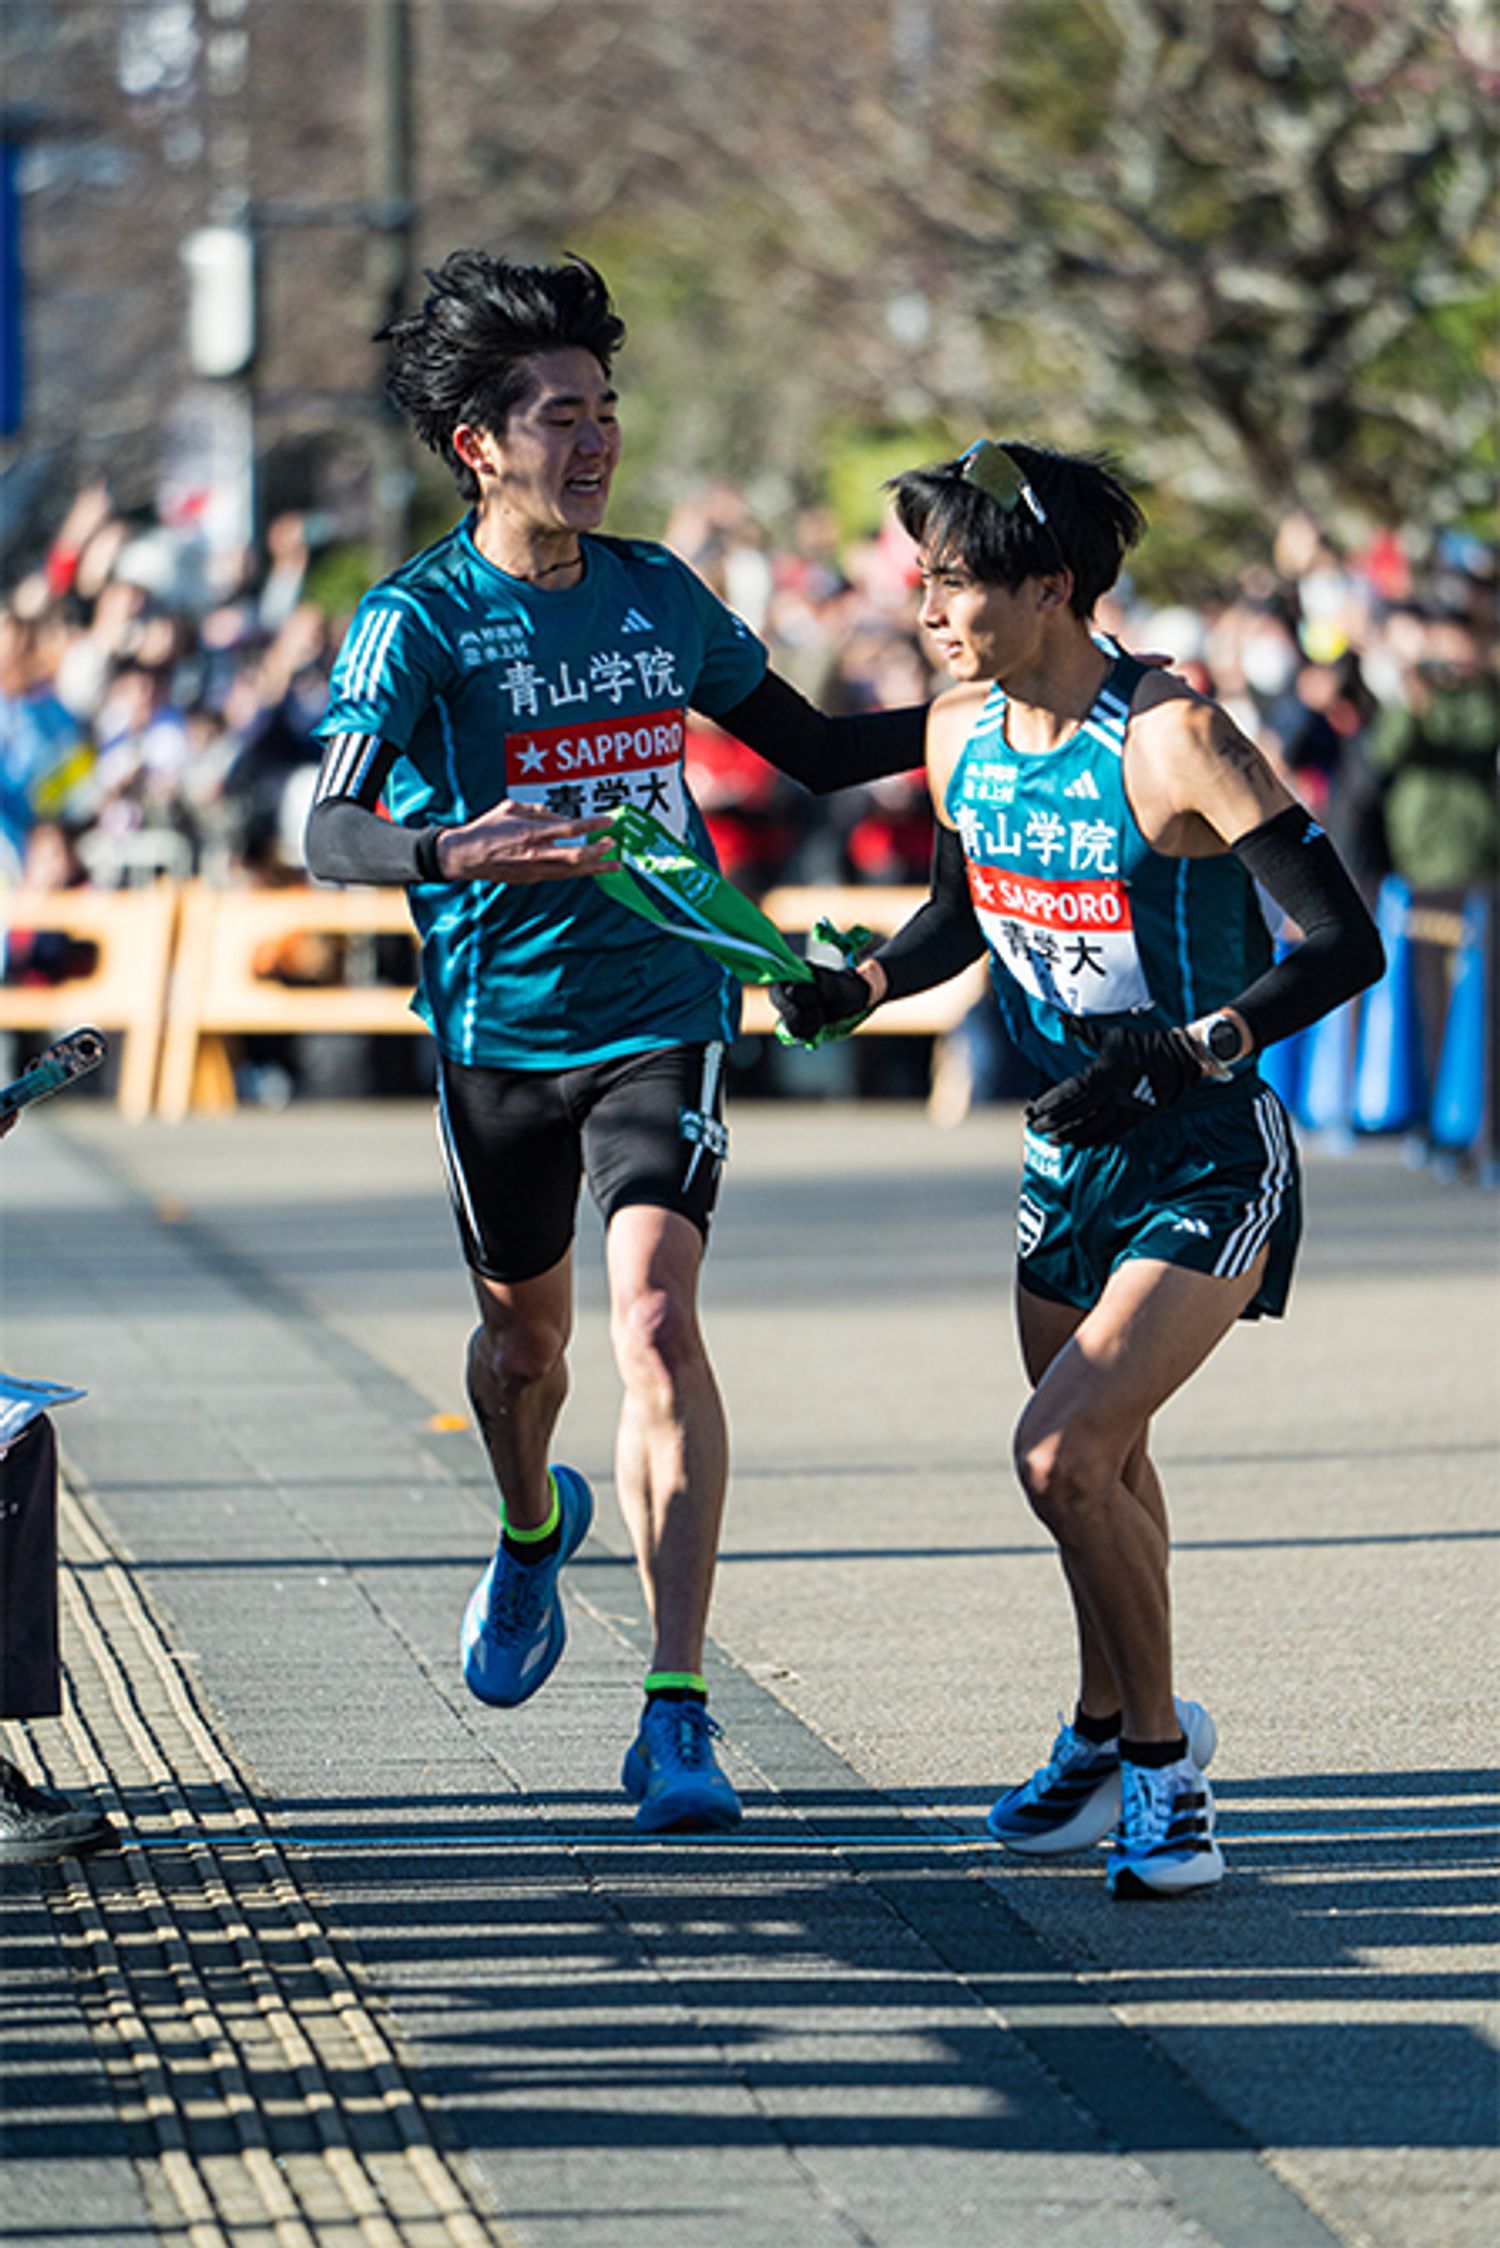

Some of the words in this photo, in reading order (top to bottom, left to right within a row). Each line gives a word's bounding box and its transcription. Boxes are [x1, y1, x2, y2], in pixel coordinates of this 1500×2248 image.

[499, 646, 684, 716] 青山学院
[556, 722, 682, 772] SAPPORO
[546, 772, 671, 818] 青学大
[954, 803, 1118, 874] 青山学院
[999, 879, 1121, 923] SAPPORO
